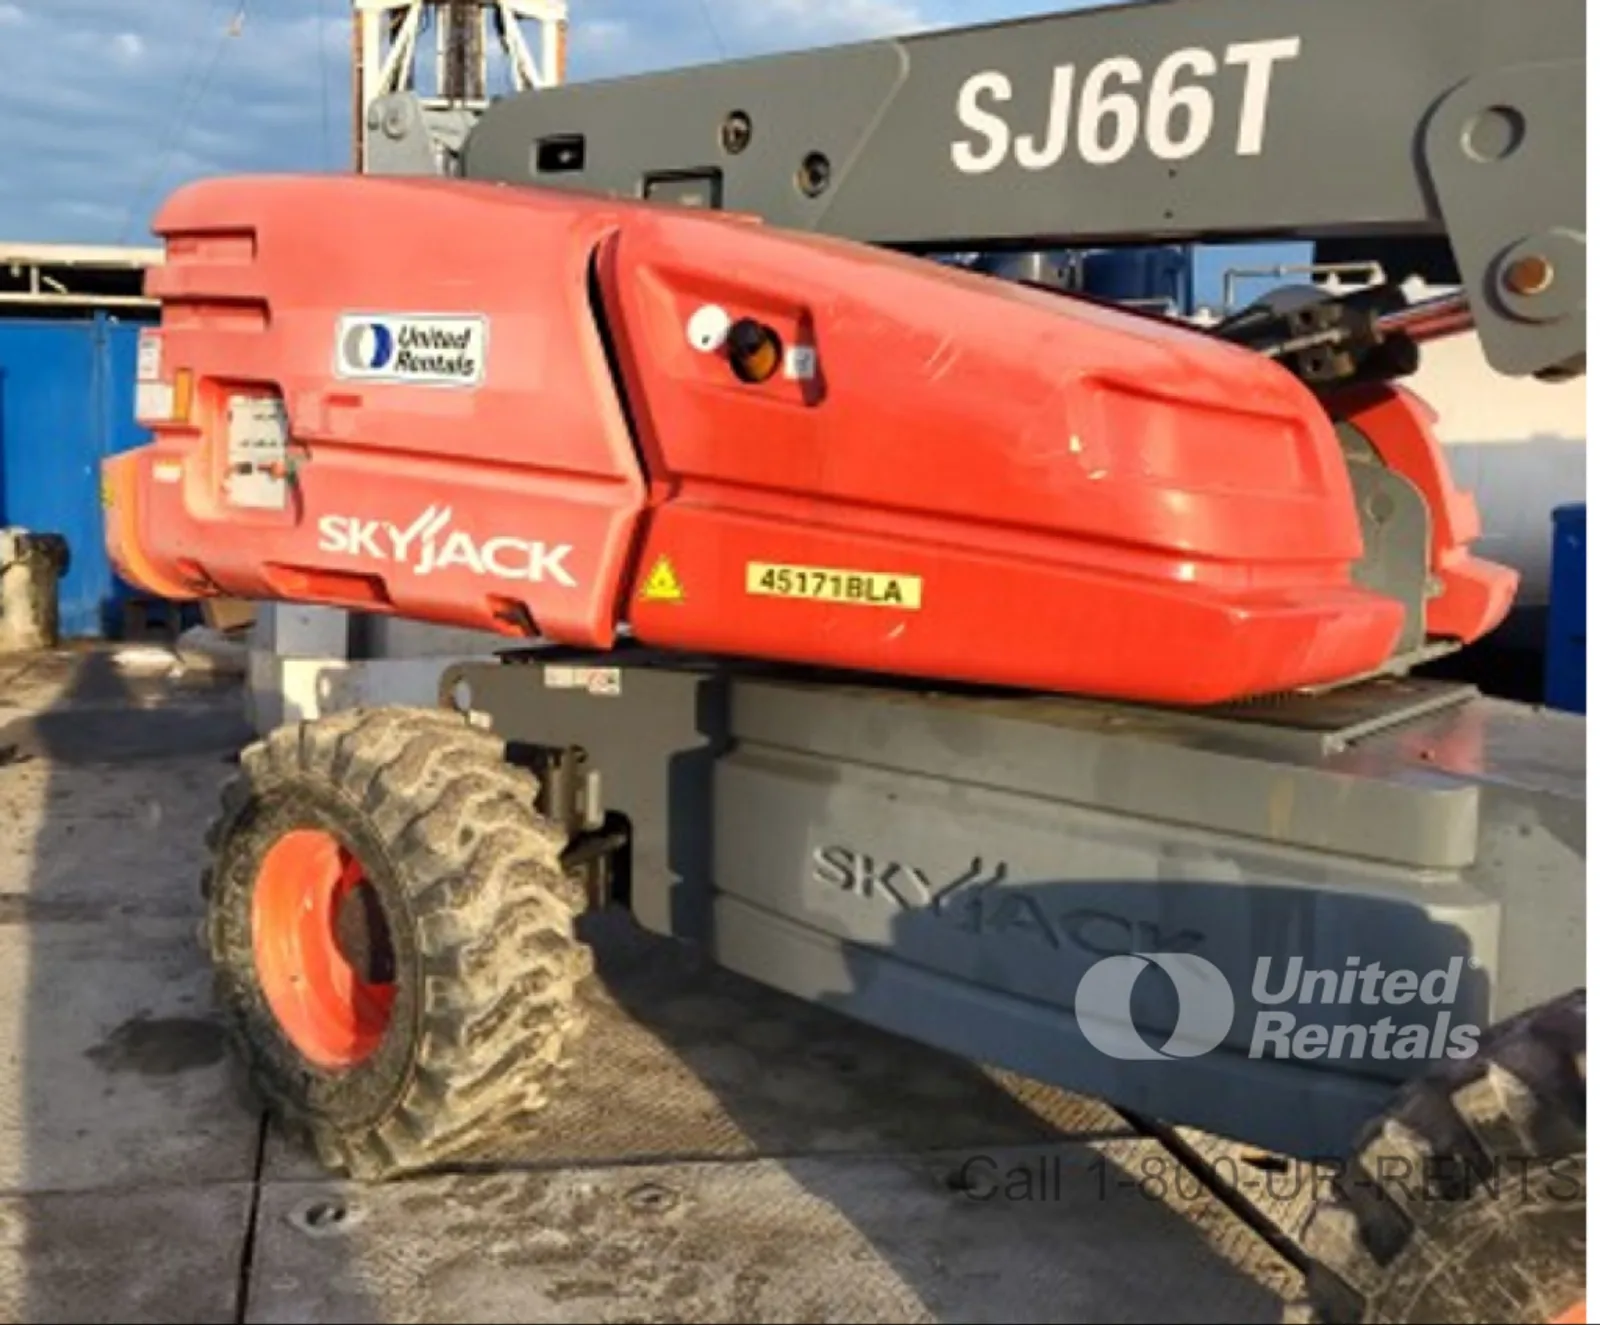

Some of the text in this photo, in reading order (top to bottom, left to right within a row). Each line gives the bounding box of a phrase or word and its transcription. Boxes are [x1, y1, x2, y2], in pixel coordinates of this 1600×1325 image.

[950, 37, 1301, 173] SJ66T
[398, 325, 472, 349] United
[394, 350, 475, 376] Rentals
[318, 505, 576, 586] SKYJACK
[761, 568, 902, 603] 45171BLA
